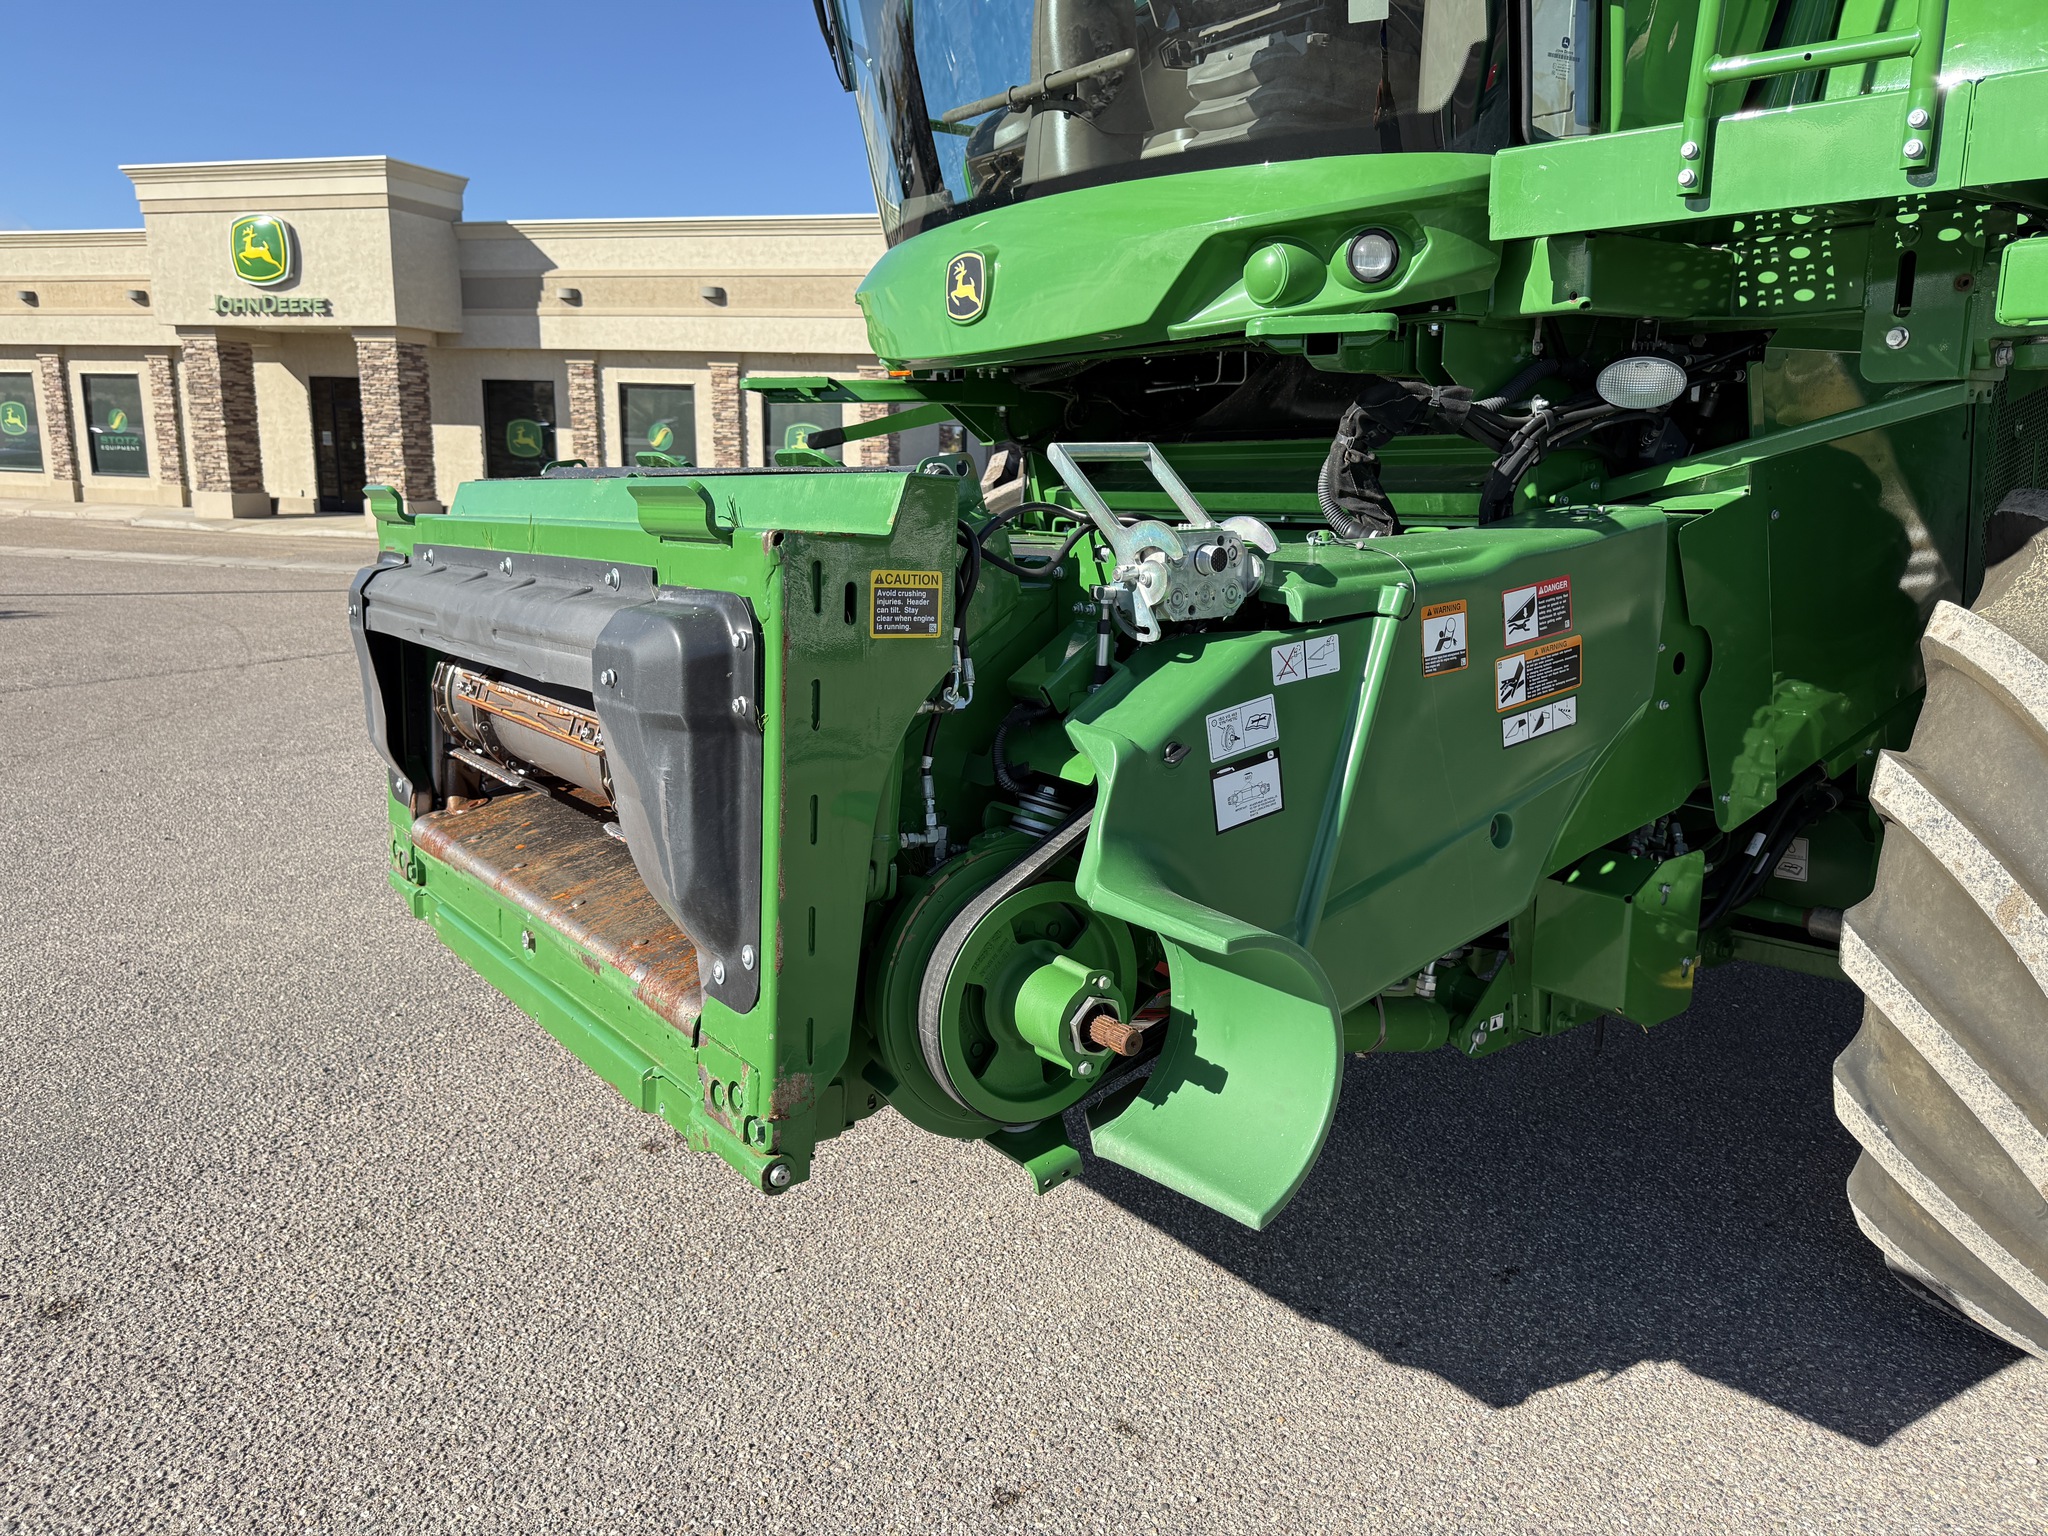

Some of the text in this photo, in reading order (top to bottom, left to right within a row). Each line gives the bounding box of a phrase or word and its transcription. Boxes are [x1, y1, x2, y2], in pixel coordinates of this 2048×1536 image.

[100, 435, 139, 445] STOTZ
[100, 444, 140, 452] EQUIPMENT
[885, 573, 938, 585] CAUTION
[1543, 580, 1568, 594] DANGER
[877, 589, 926, 598] Avoid crushing
[877, 598, 903, 606] injuries.
[904, 606, 919, 615] Stay
[1433, 602, 1461, 614] WARNING
[913, 615, 935, 623] engine
[884, 623, 911, 631] running.
[1540, 640, 1568, 653] WARNING
